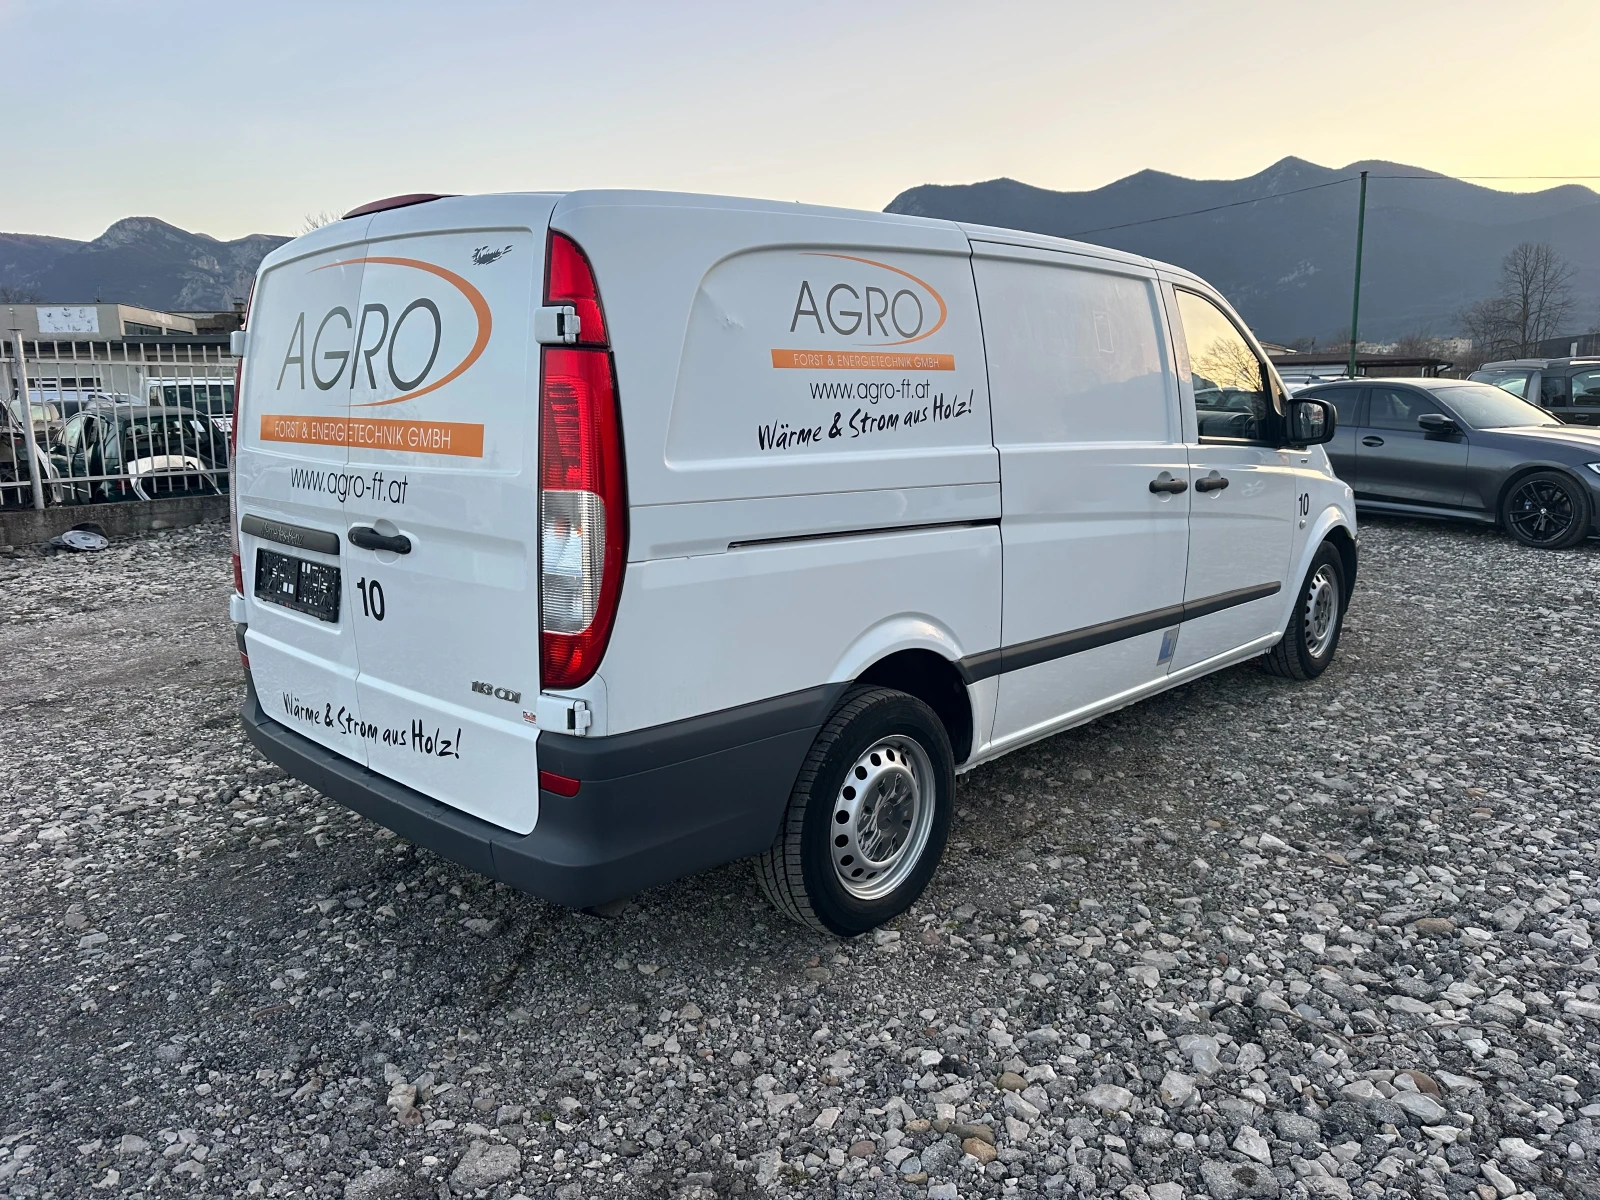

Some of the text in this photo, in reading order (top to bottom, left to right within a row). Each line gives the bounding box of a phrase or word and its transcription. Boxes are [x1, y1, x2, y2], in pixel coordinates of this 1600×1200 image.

[789, 280, 924, 339] AGRO
[276, 297, 442, 391] AGRO
[793, 353, 940, 368] FORST & ENERGIETECHNIK GMBH
[809, 378, 931, 405] www.agro-ft.at
[274, 420, 451, 449] FORST & ENERGIETECHNIK GMBH
[758, 388, 974, 451] Wärme & Strom aus Holz!
[291, 467, 409, 504] www.agro-ft.at
[1298, 492, 1310, 517] 10
[356, 576, 386, 622] 10
[494, 687, 522, 704] CDI
[282, 690, 462, 759] Wärme & Strom aus Holz!
